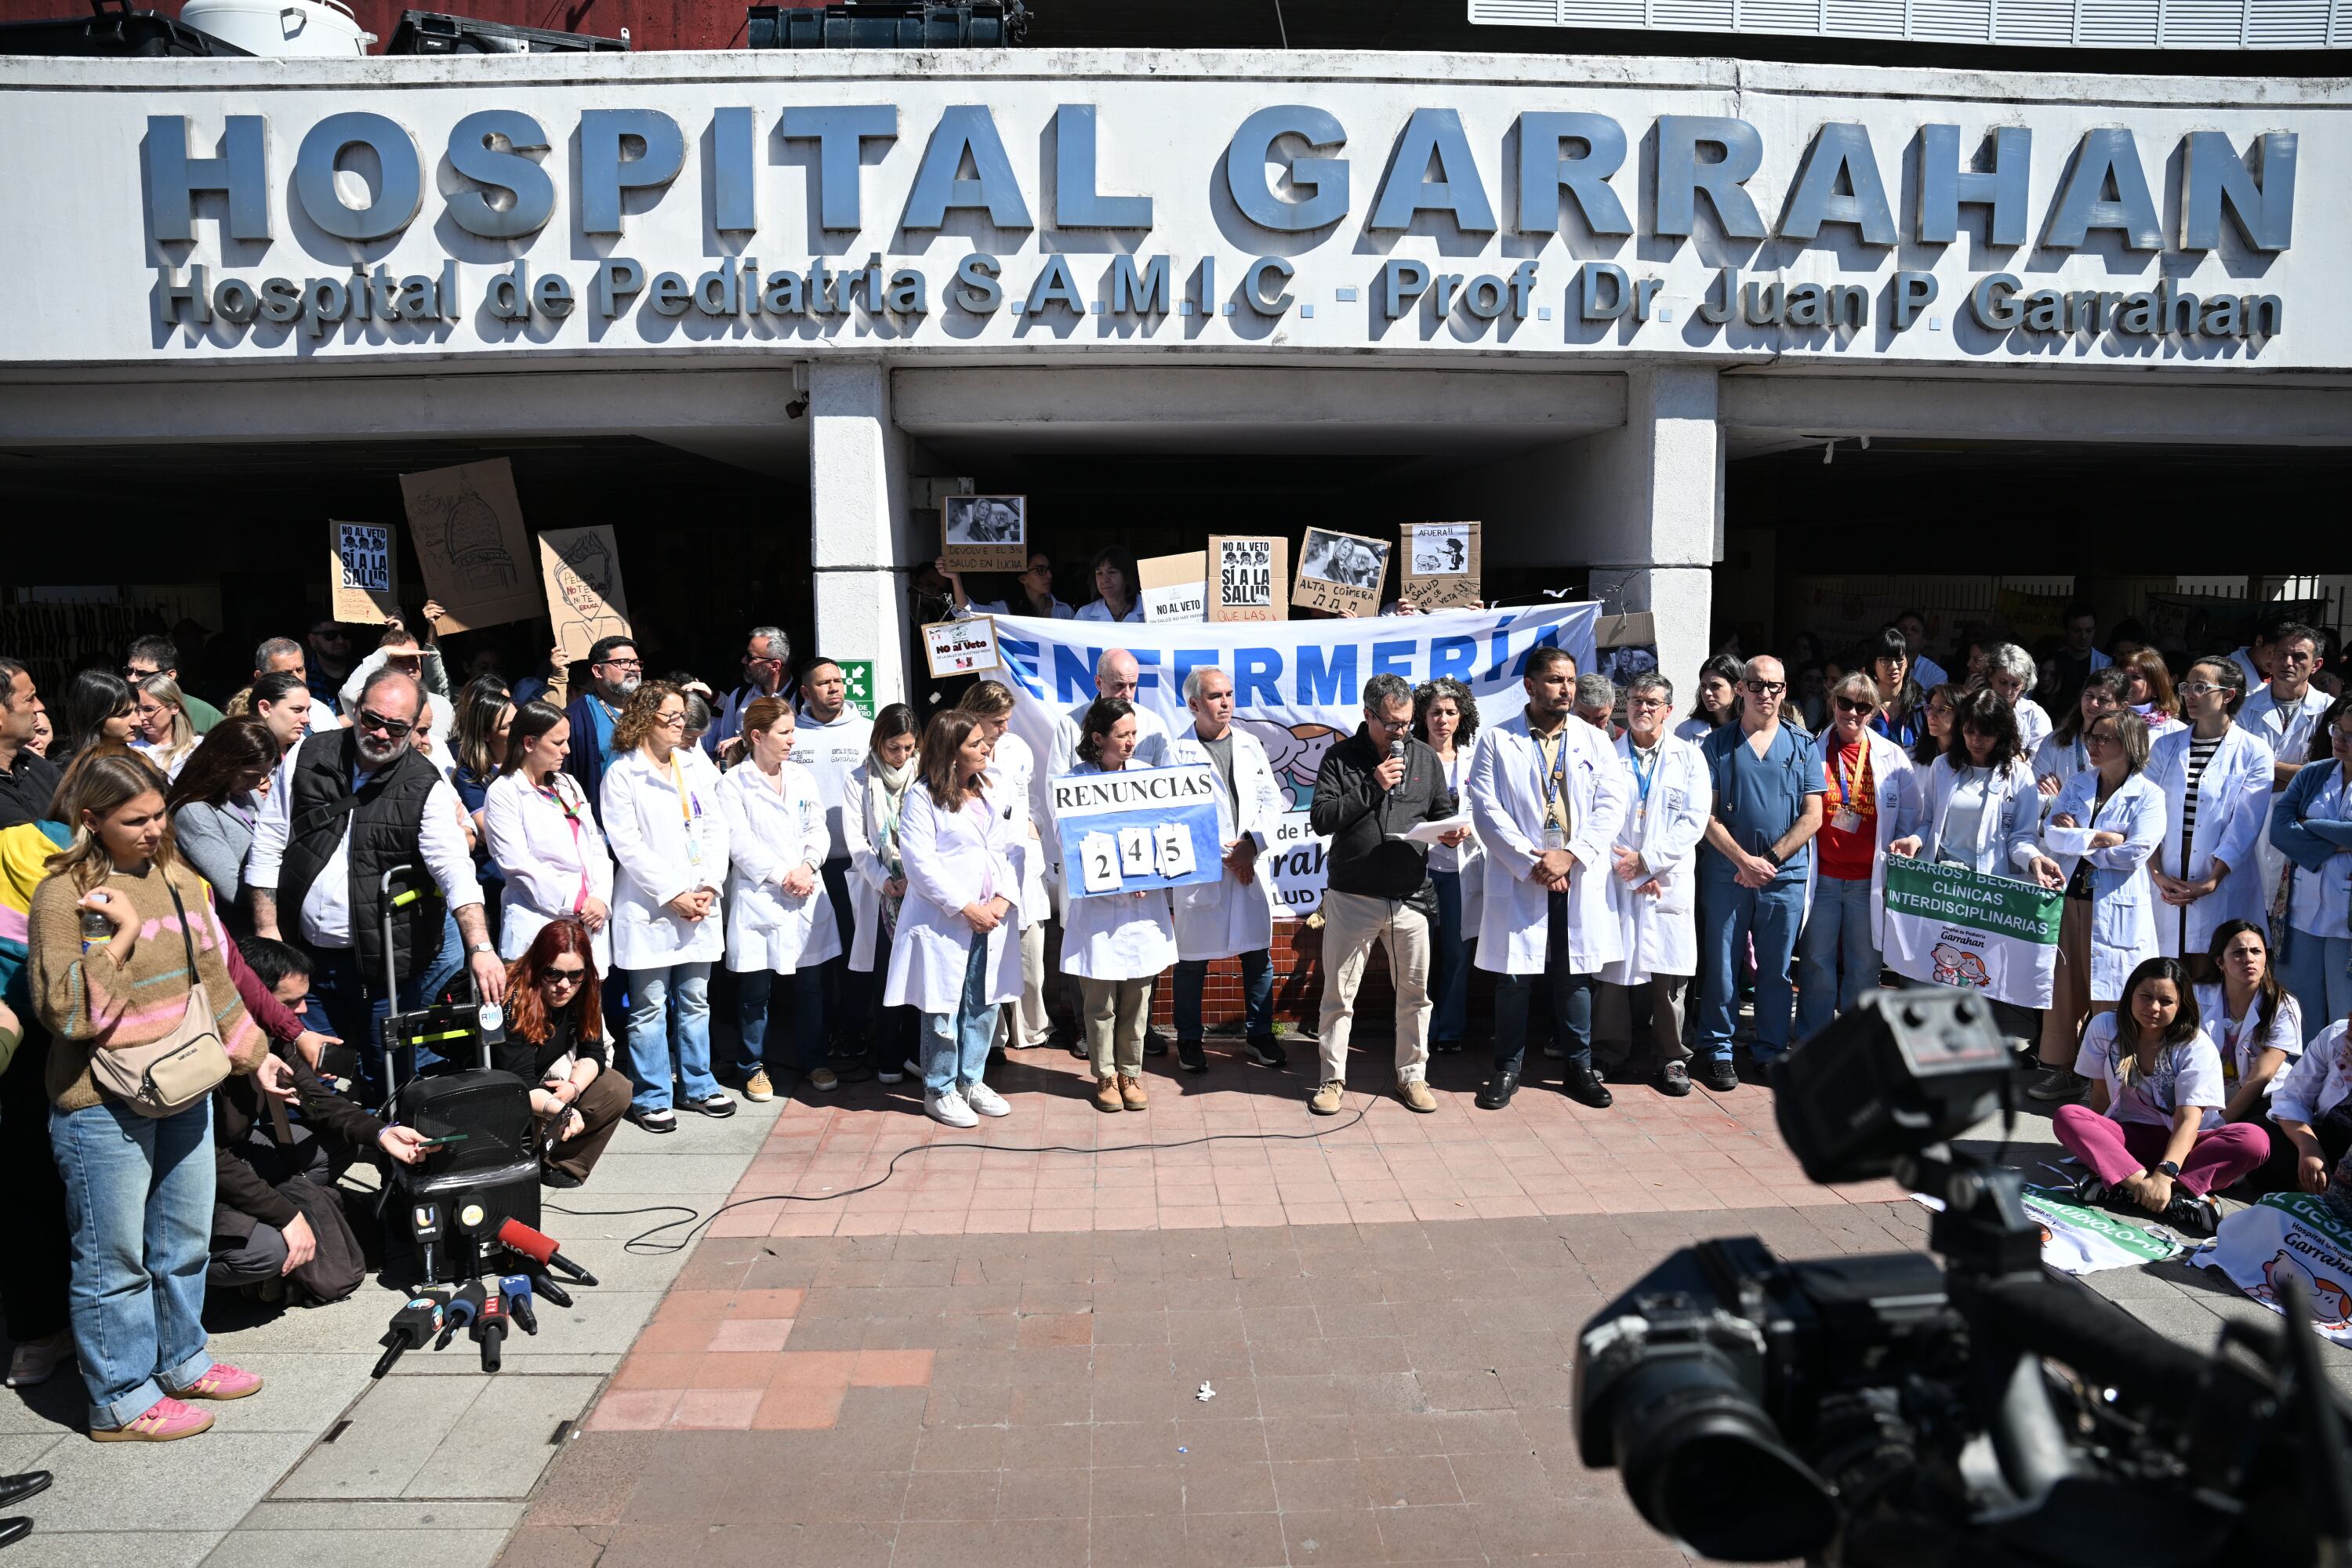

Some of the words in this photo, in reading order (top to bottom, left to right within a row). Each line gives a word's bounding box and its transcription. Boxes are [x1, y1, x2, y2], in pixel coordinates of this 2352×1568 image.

[147, 103, 1153, 242] HOSPITAL
[1227, 104, 2299, 252] GARRAHAN
[158, 259, 460, 338] Hospital
[486, 258, 575, 321] de
[599, 252, 927, 320] Pediatria
[956, 253, 1314, 318] S.A.M.I.C.
[1385, 259, 1552, 321] Prof.
[1581, 261, 1671, 324] Dr.
[1702, 264, 1869, 329] Juan
[1893, 270, 1942, 332] P.
[1971, 270, 2284, 337] Garrahan
[342, 525, 352, 535] NO
[354, 527, 365, 537] AL
[367, 528, 385, 539] VETO
[948, 546, 988, 554] DEVOLVE
[1222, 542, 1234, 552] NO
[1236, 542, 1247, 551] AL
[1249, 542, 1269, 551] VETO
[342, 549, 354, 568] SÍ
[359, 554, 367, 569] A
[372, 554, 387, 571] LA
[949, 558, 977, 568] SALUD
[980, 559, 993, 568] EN
[997, 559, 1022, 569] LUCHA
[343, 568, 387, 586] SALUD
[1221, 564, 1236, 586] SÍ
[1240, 569, 1249, 585] A
[1253, 569, 1269, 585] LA
[567, 586, 576, 595] NO
[576, 585, 590, 593] TE
[1300, 579, 1325, 593] ALTA
[1404, 583, 1416, 594] LA
[1411, 579, 1439, 601] SALUD
[580, 594, 593, 603] TE
[1221, 586, 1270, 603] SALUD
[1421, 597, 1432, 607] NO
[1434, 589, 1442, 598] SE
[1439, 593, 1458, 604] VETA
[1156, 604, 1167, 615] NO
[1169, 603, 1180, 613] AL
[1180, 600, 1200, 612] VETO
[1218, 610, 1239, 622] QUE
[1244, 610, 1266, 620] LAS
[936, 645, 950, 654] NO
[953, 643, 962, 652] al
[964, 641, 987, 650] Veto
[1055, 773, 1212, 809] RENUNCIAS
[1277, 824, 1298, 840] de
[1888, 854, 1963, 880] BECARIOS
[1976, 873, 2057, 900] BECARIAS
[1933, 881, 2003, 906] CLÍNICAS
[1889, 889, 2049, 935] INTERDISCIPLINARIAS
[1942, 925, 1958, 935] Hospital
[1940, 931, 1984, 949] Garrahan
[2292, 1222, 2326, 1246] Hospital
